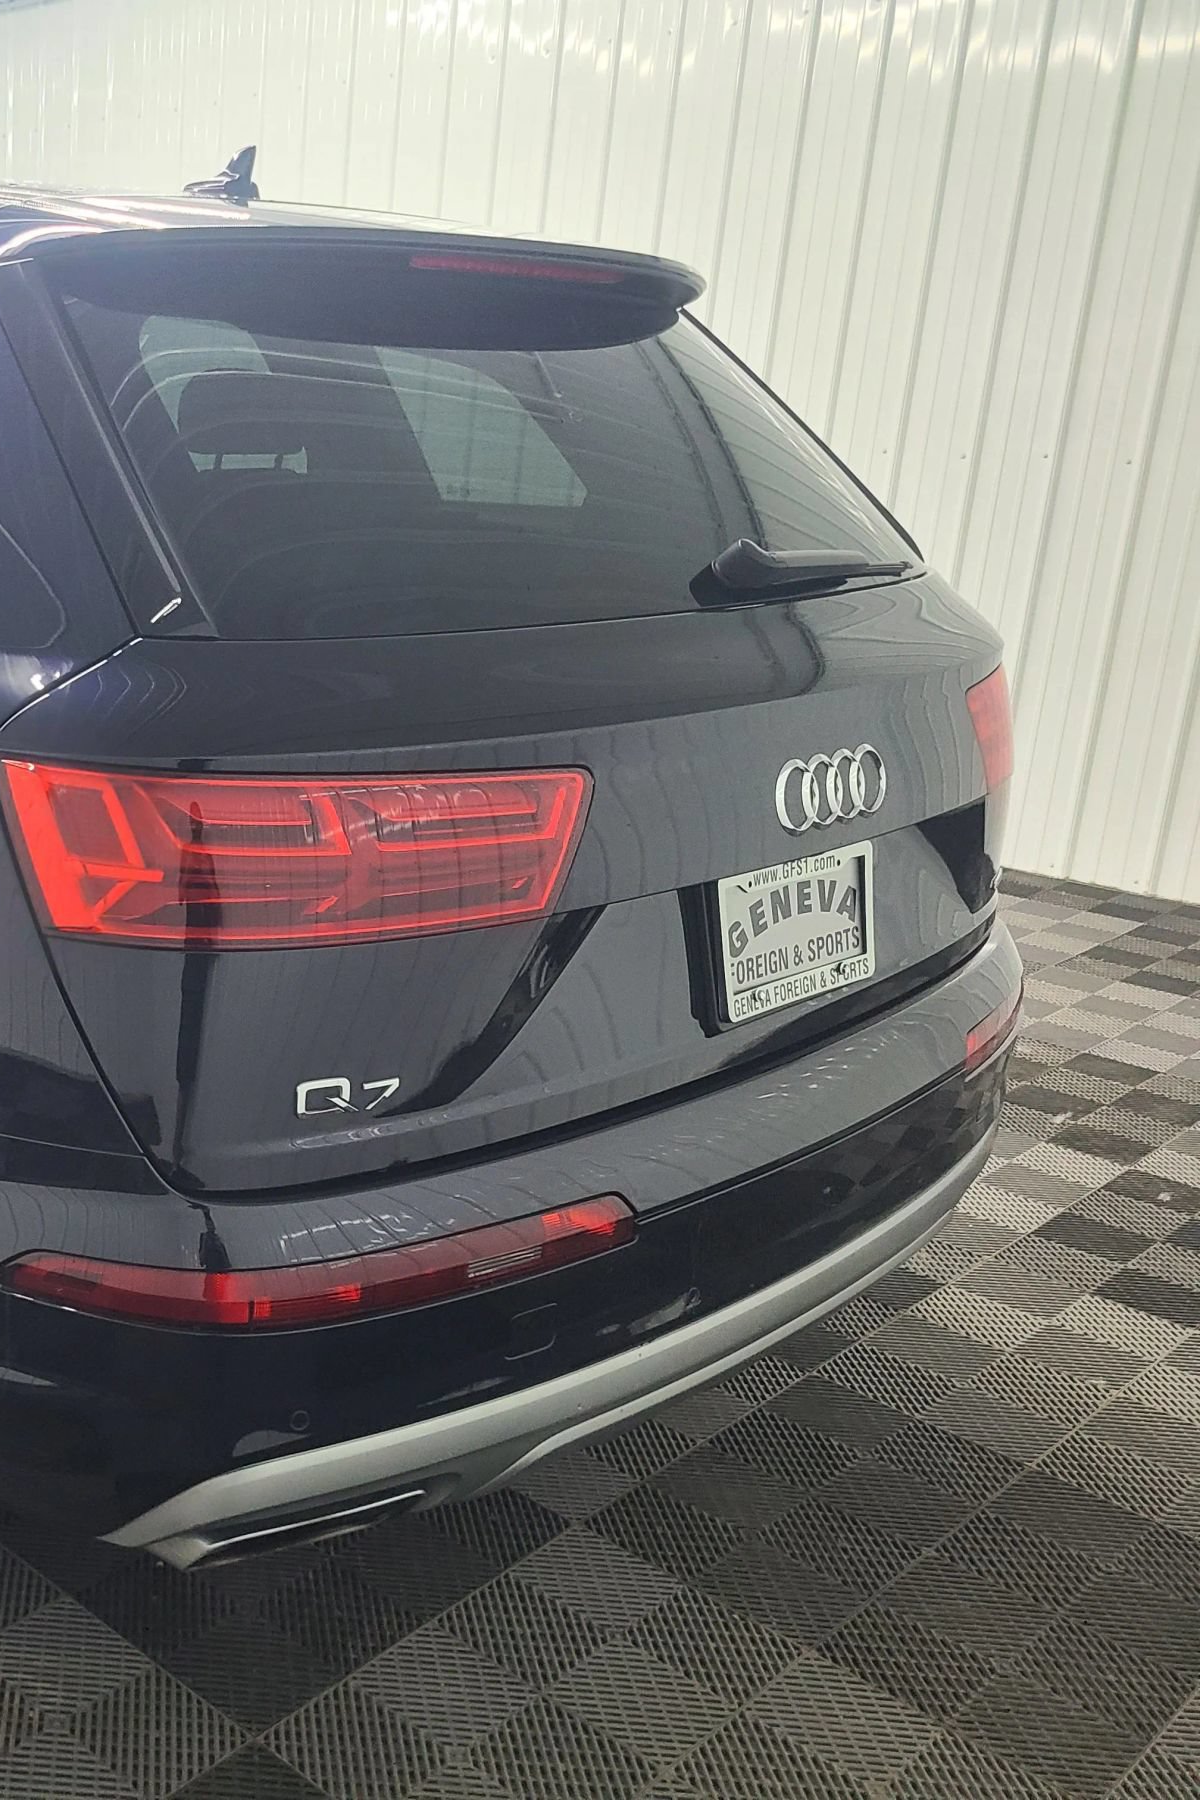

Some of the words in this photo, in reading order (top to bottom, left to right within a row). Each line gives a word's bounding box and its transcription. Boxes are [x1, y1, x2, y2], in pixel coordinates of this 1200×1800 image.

[753, 855, 836, 887] www.GFS1.com
[728, 879, 857, 958] GENEVA
[793, 944, 804, 966] &
[807, 926, 860, 963] SPORTS
[774, 977, 817, 1004] FOREIGN
[820, 972, 827, 988] &
[297, 1077, 400, 1115] Q7
